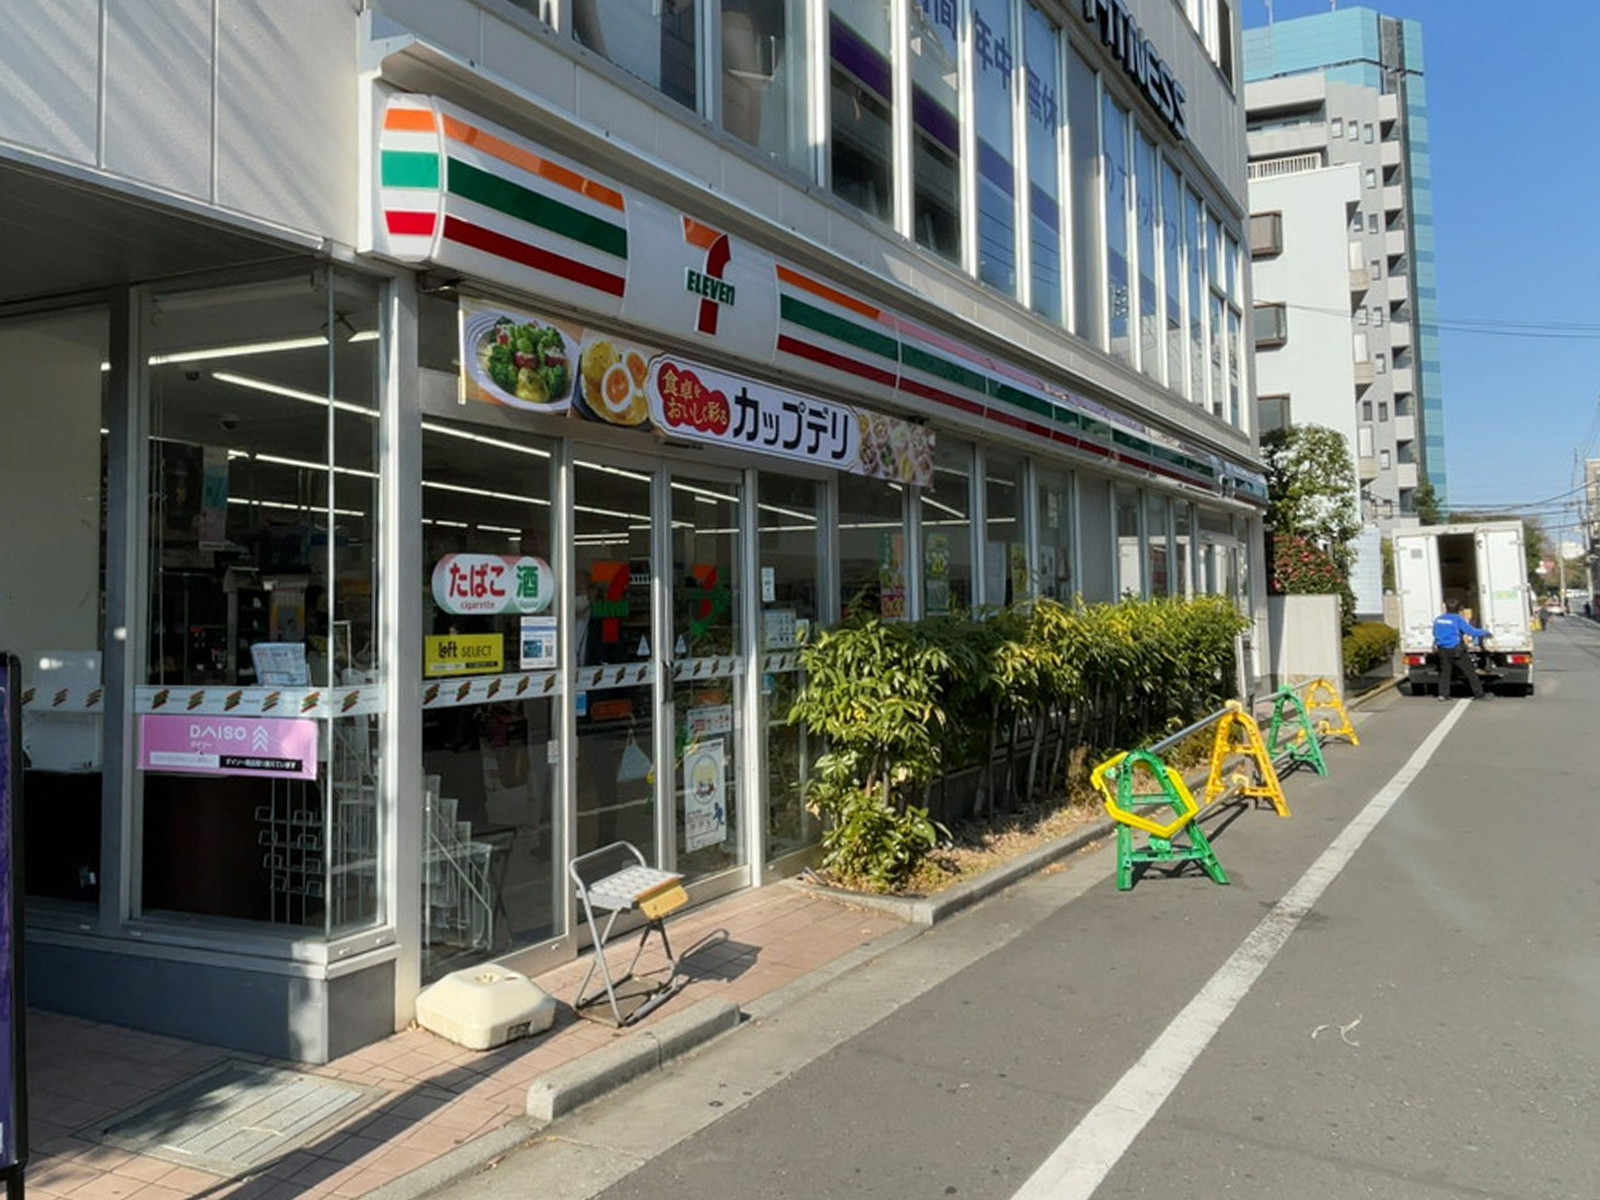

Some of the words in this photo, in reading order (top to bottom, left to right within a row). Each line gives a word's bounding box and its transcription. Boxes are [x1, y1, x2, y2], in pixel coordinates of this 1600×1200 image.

[732, 387, 848, 460] カップデリ
[449, 563, 506, 598] たばこ
[516, 565, 539, 598] 酒
[461, 644, 493, 657] SELECT
[190, 724, 246, 741] DAISO
